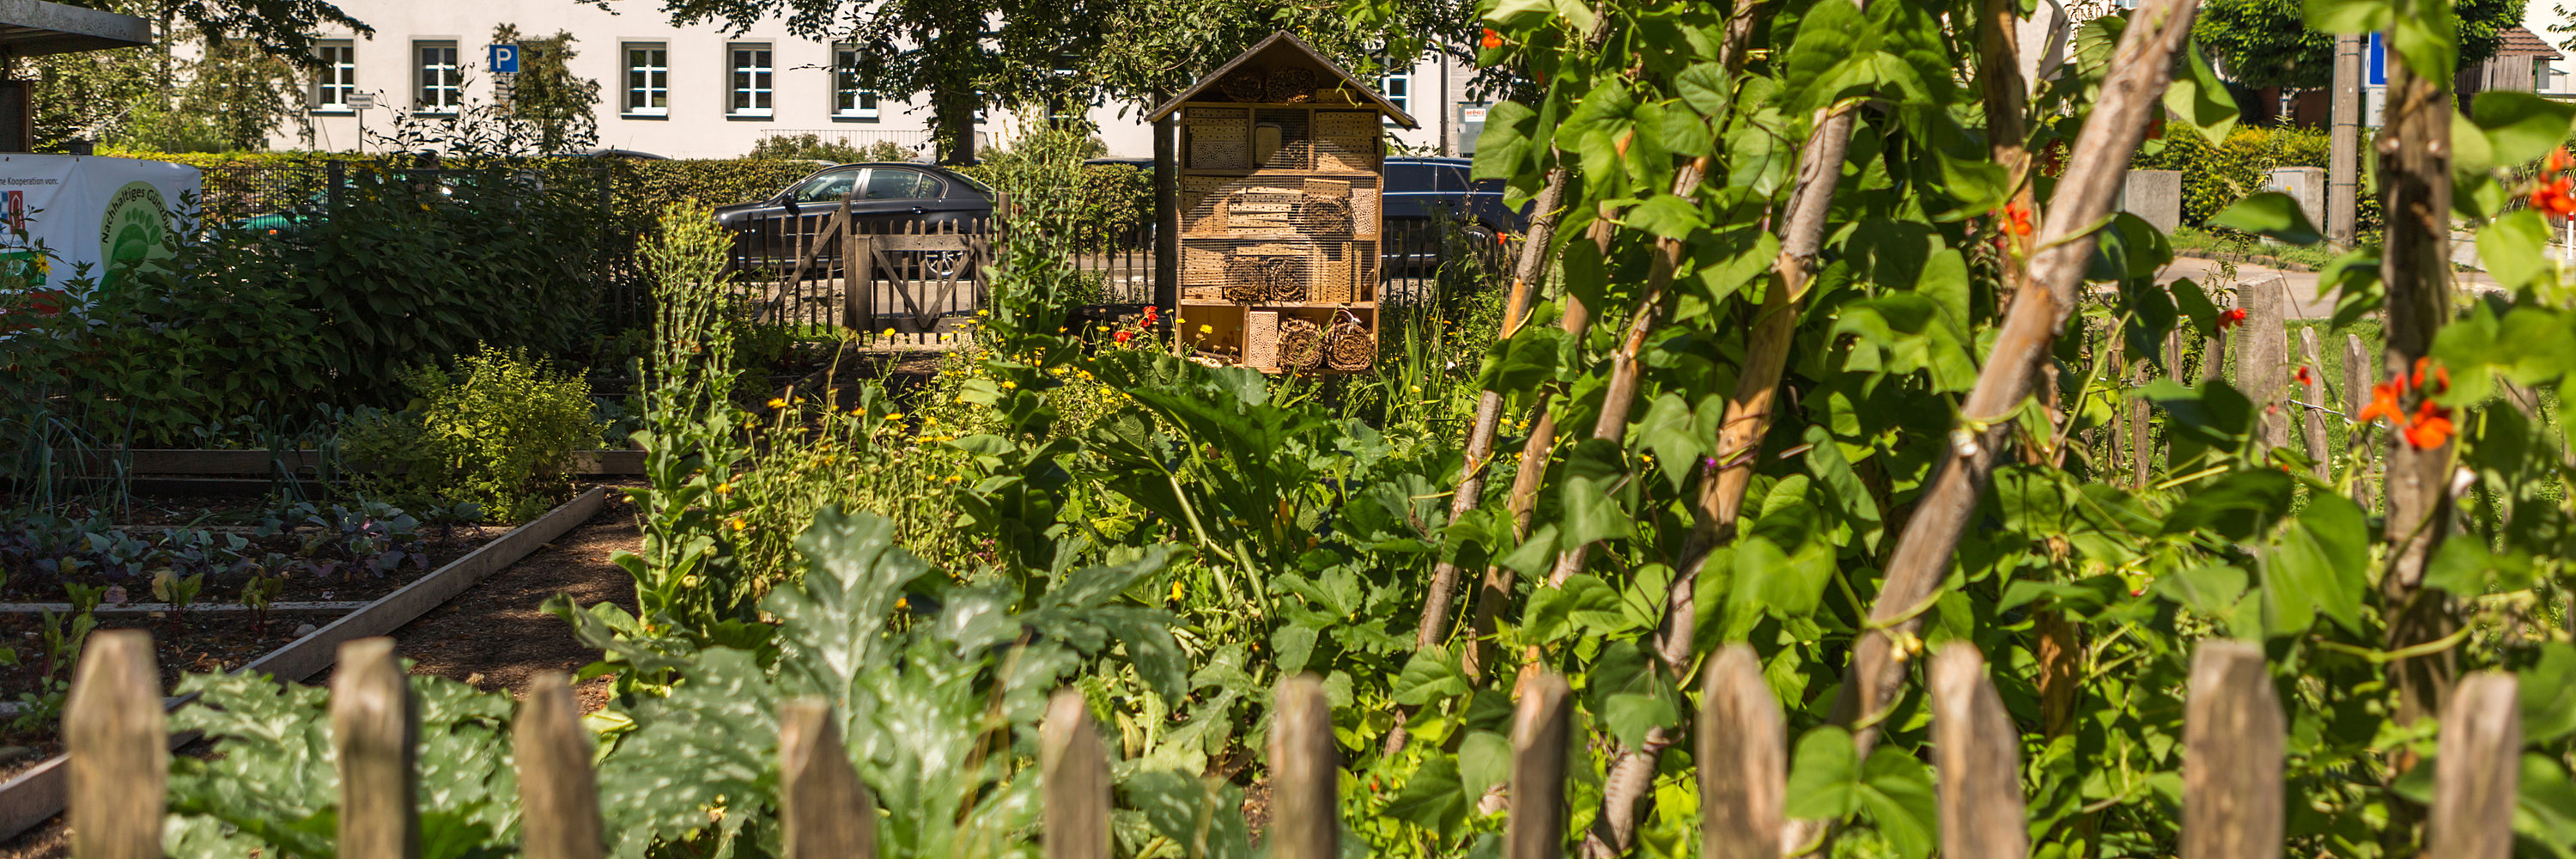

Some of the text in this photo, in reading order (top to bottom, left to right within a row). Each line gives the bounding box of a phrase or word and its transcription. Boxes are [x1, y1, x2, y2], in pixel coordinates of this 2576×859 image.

[496, 48, 512, 69] P
[8, 177, 44, 186] Kooperation
[102, 187, 145, 244] Nachhaltiges
